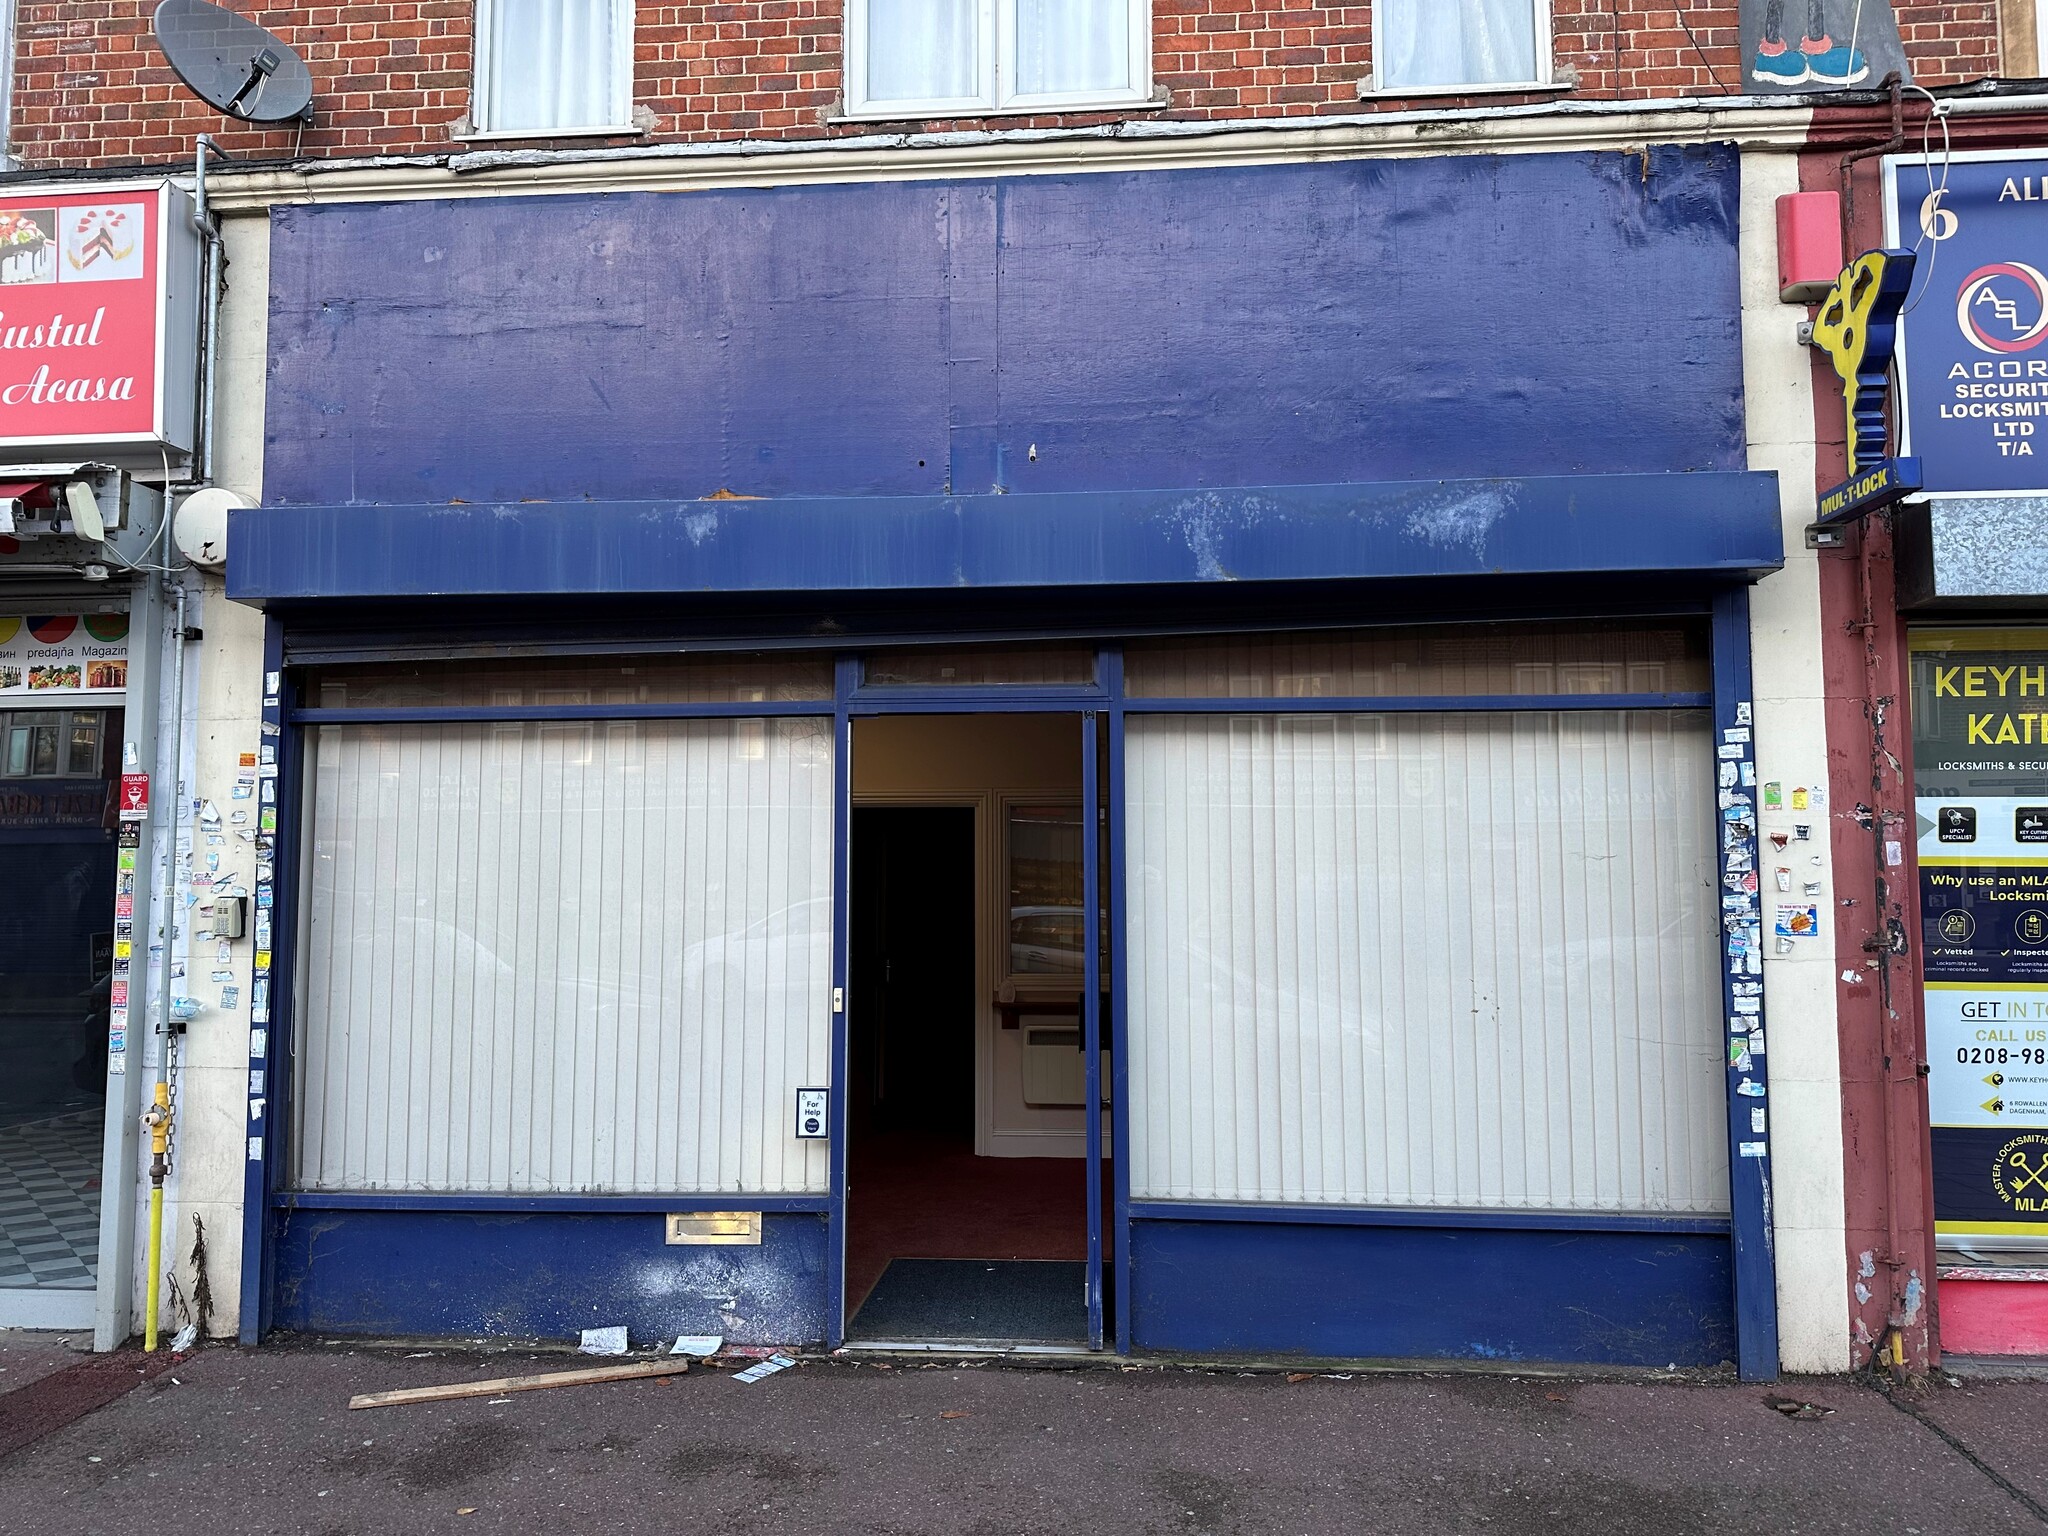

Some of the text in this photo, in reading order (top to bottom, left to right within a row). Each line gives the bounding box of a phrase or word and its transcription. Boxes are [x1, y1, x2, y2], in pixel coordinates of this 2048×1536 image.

[1919, 189, 1959, 241] 6
[1975, 286, 2032, 331] ASL
[0, 306, 105, 349] ustul
[1947, 360, 2048, 379] ACOR
[2, 364, 136, 405] Acasa
[1955, 382, 2048, 399] SECURIT
[1993, 421, 2035, 437] LTD
[1997, 441, 2034, 456] T/A
[27, 646, 74, 660] predajňa
[81, 646, 128, 659] Magazin
[1935, 665, 2045, 697] KEYH
[1938, 761, 2048, 771] LOCKSMITHS & SECU
[123, 775, 149, 783] GUARD
[1930, 875, 1964, 888] Why
[1968, 877, 1994, 886] use
[1998, 878, 2016, 886] an
[1944, 948, 1974, 956] Vetted
[1961, 1001, 2048, 1018] GET IN T
[1975, 1029, 2047, 1042] CALL US
[1957, 1047, 2048, 1065] 0208-98
[1993, 1134, 2048, 1203] MASTER LOCKSMITH
